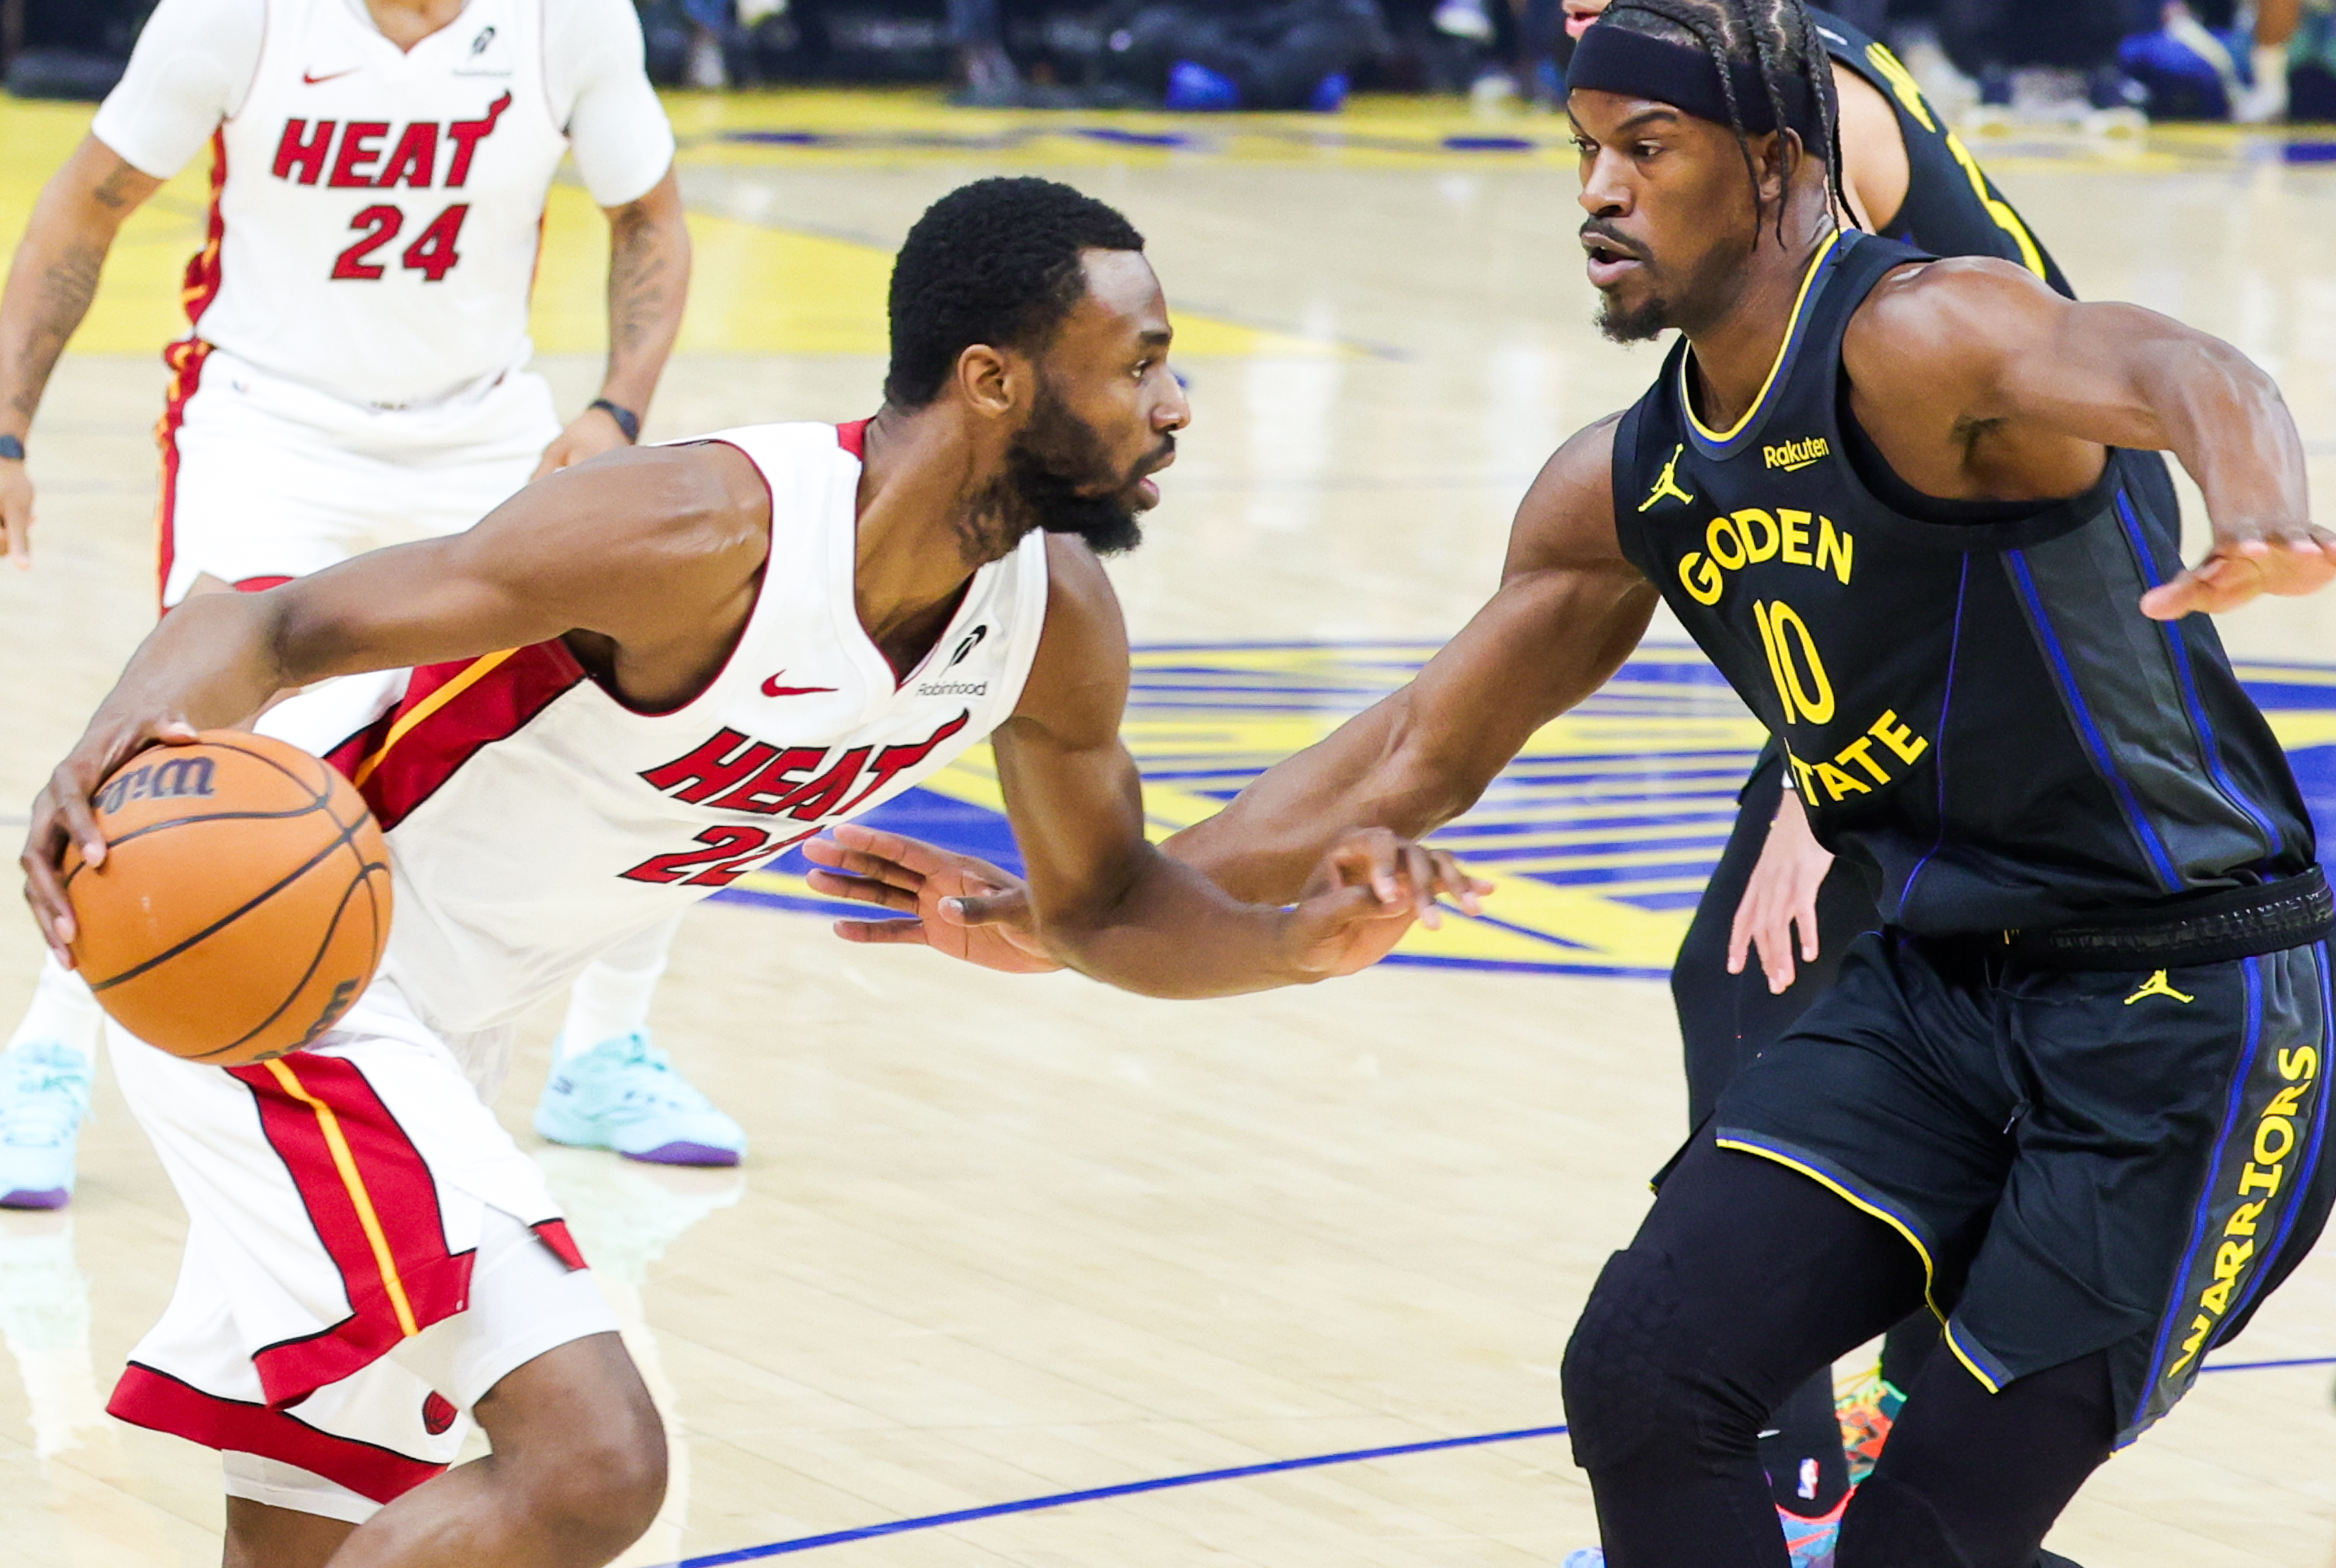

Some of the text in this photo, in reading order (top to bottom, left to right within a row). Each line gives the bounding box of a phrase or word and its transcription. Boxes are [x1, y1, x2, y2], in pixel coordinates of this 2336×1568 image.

[271, 89, 513, 189] HEAT
[329, 204, 471, 281] 24
[1763, 436, 1830, 469] Rakuten
[1679, 508, 1854, 606] GODEN
[915, 680, 989, 696] Robinhood
[1753, 599, 1835, 725] 10
[636, 708, 969, 821] HEAT
[1784, 709, 1929, 807] TATE
[2168, 1045, 2317, 1378] WARRIORS
